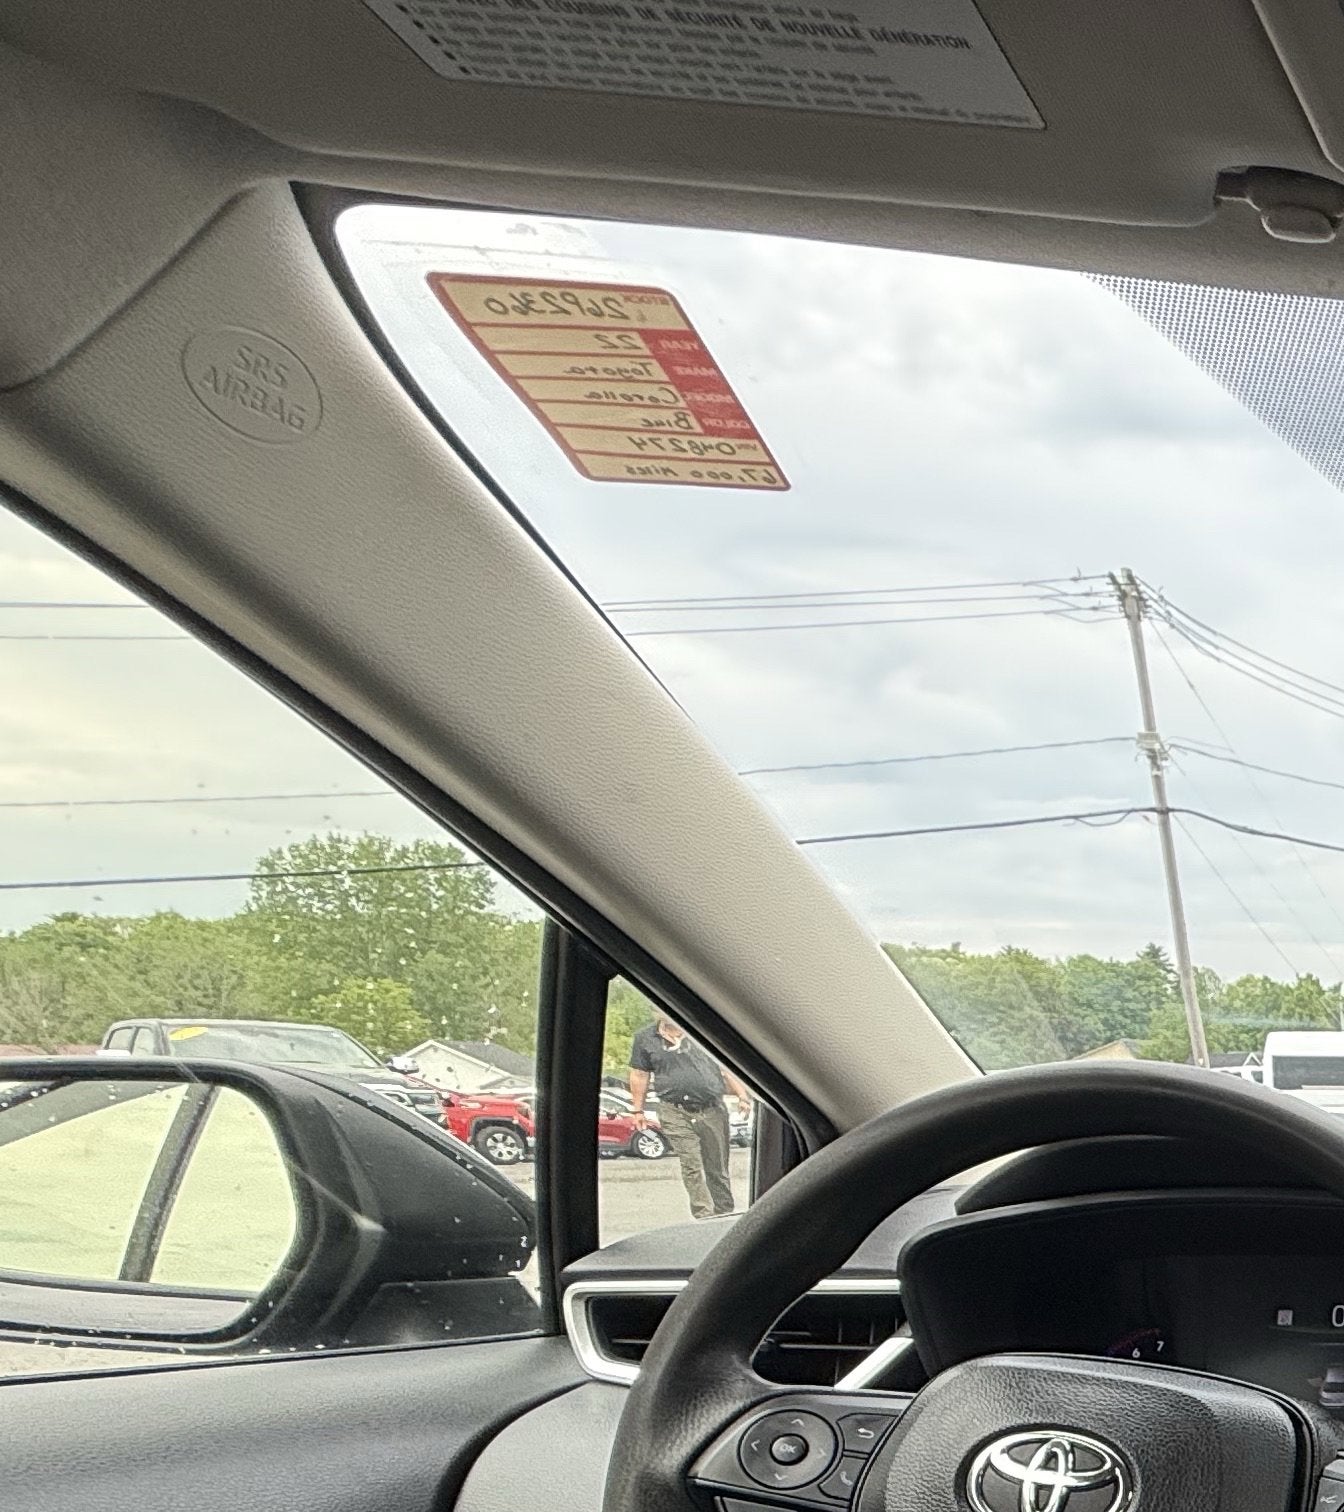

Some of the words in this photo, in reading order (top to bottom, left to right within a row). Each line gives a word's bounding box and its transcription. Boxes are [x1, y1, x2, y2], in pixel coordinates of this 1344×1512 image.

[781, 20, 863, 40] NOUVELLE
[233, 344, 290, 389] SRS
[198, 366, 307, 432] AIRBAG
[1132, 1347, 1141, 1359] 6
[1156, 1340, 1165, 1352] 7
[780, 1444, 796, 1454] OK
